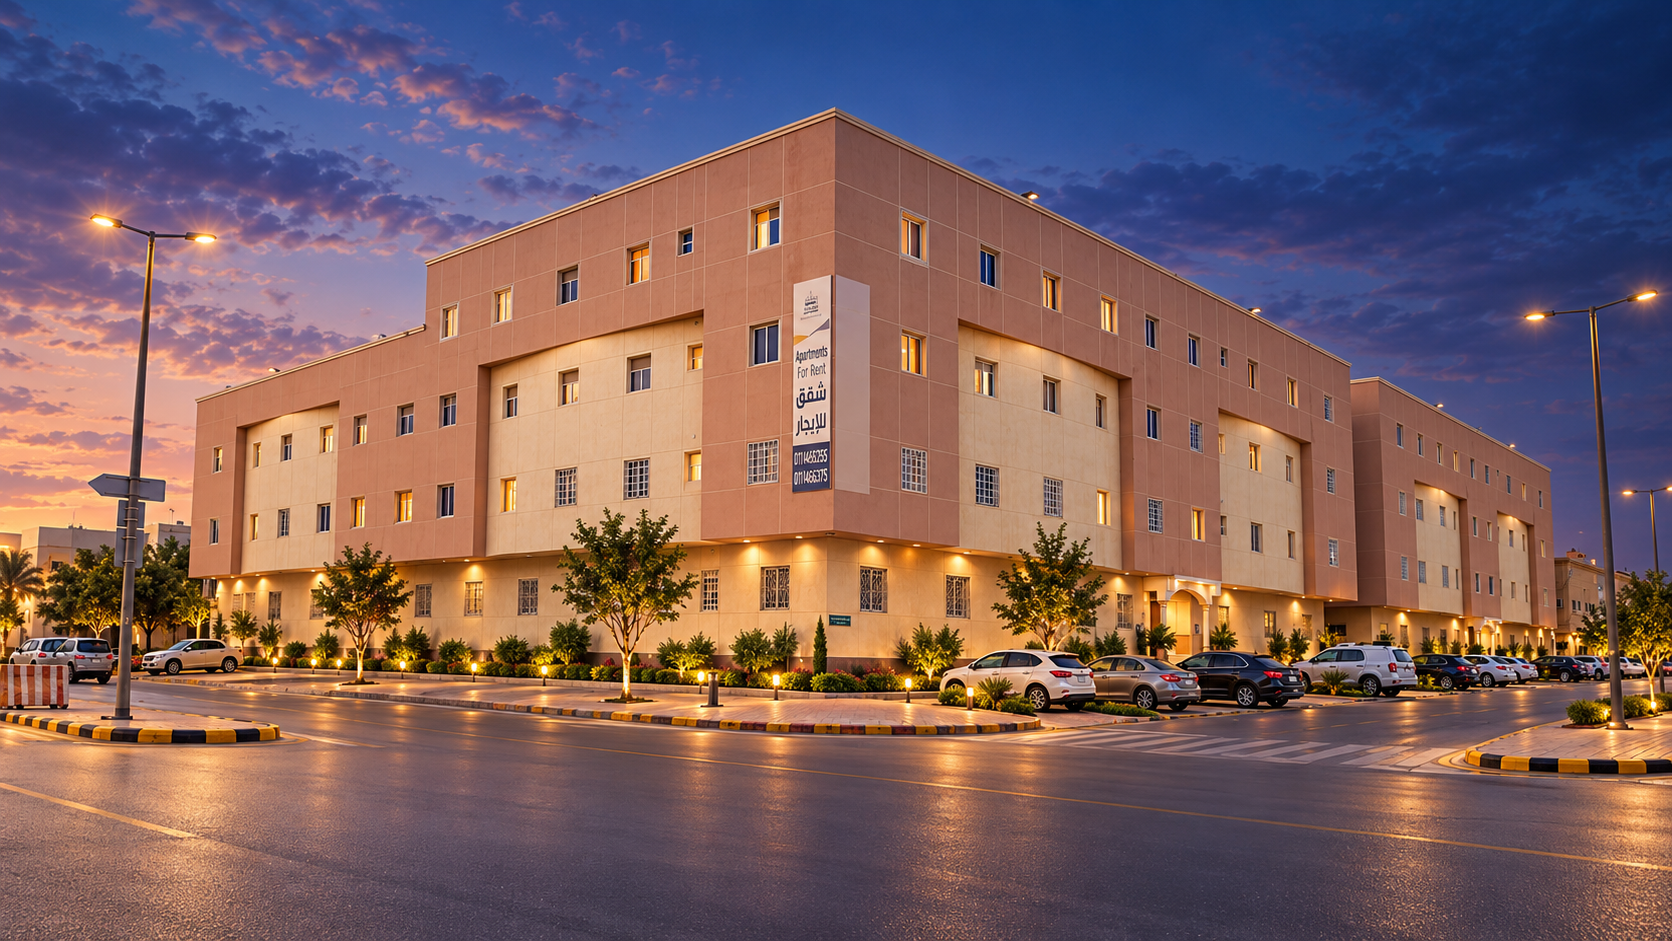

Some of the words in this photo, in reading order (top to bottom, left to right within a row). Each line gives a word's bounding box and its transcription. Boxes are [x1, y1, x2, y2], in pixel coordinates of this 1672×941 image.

[795, 345, 828, 364] Apartments
[797, 366, 808, 379] For
[810, 362, 826, 377] Rent
[796, 381, 826, 409] شقق
[795, 412, 826, 437] للإيجار
